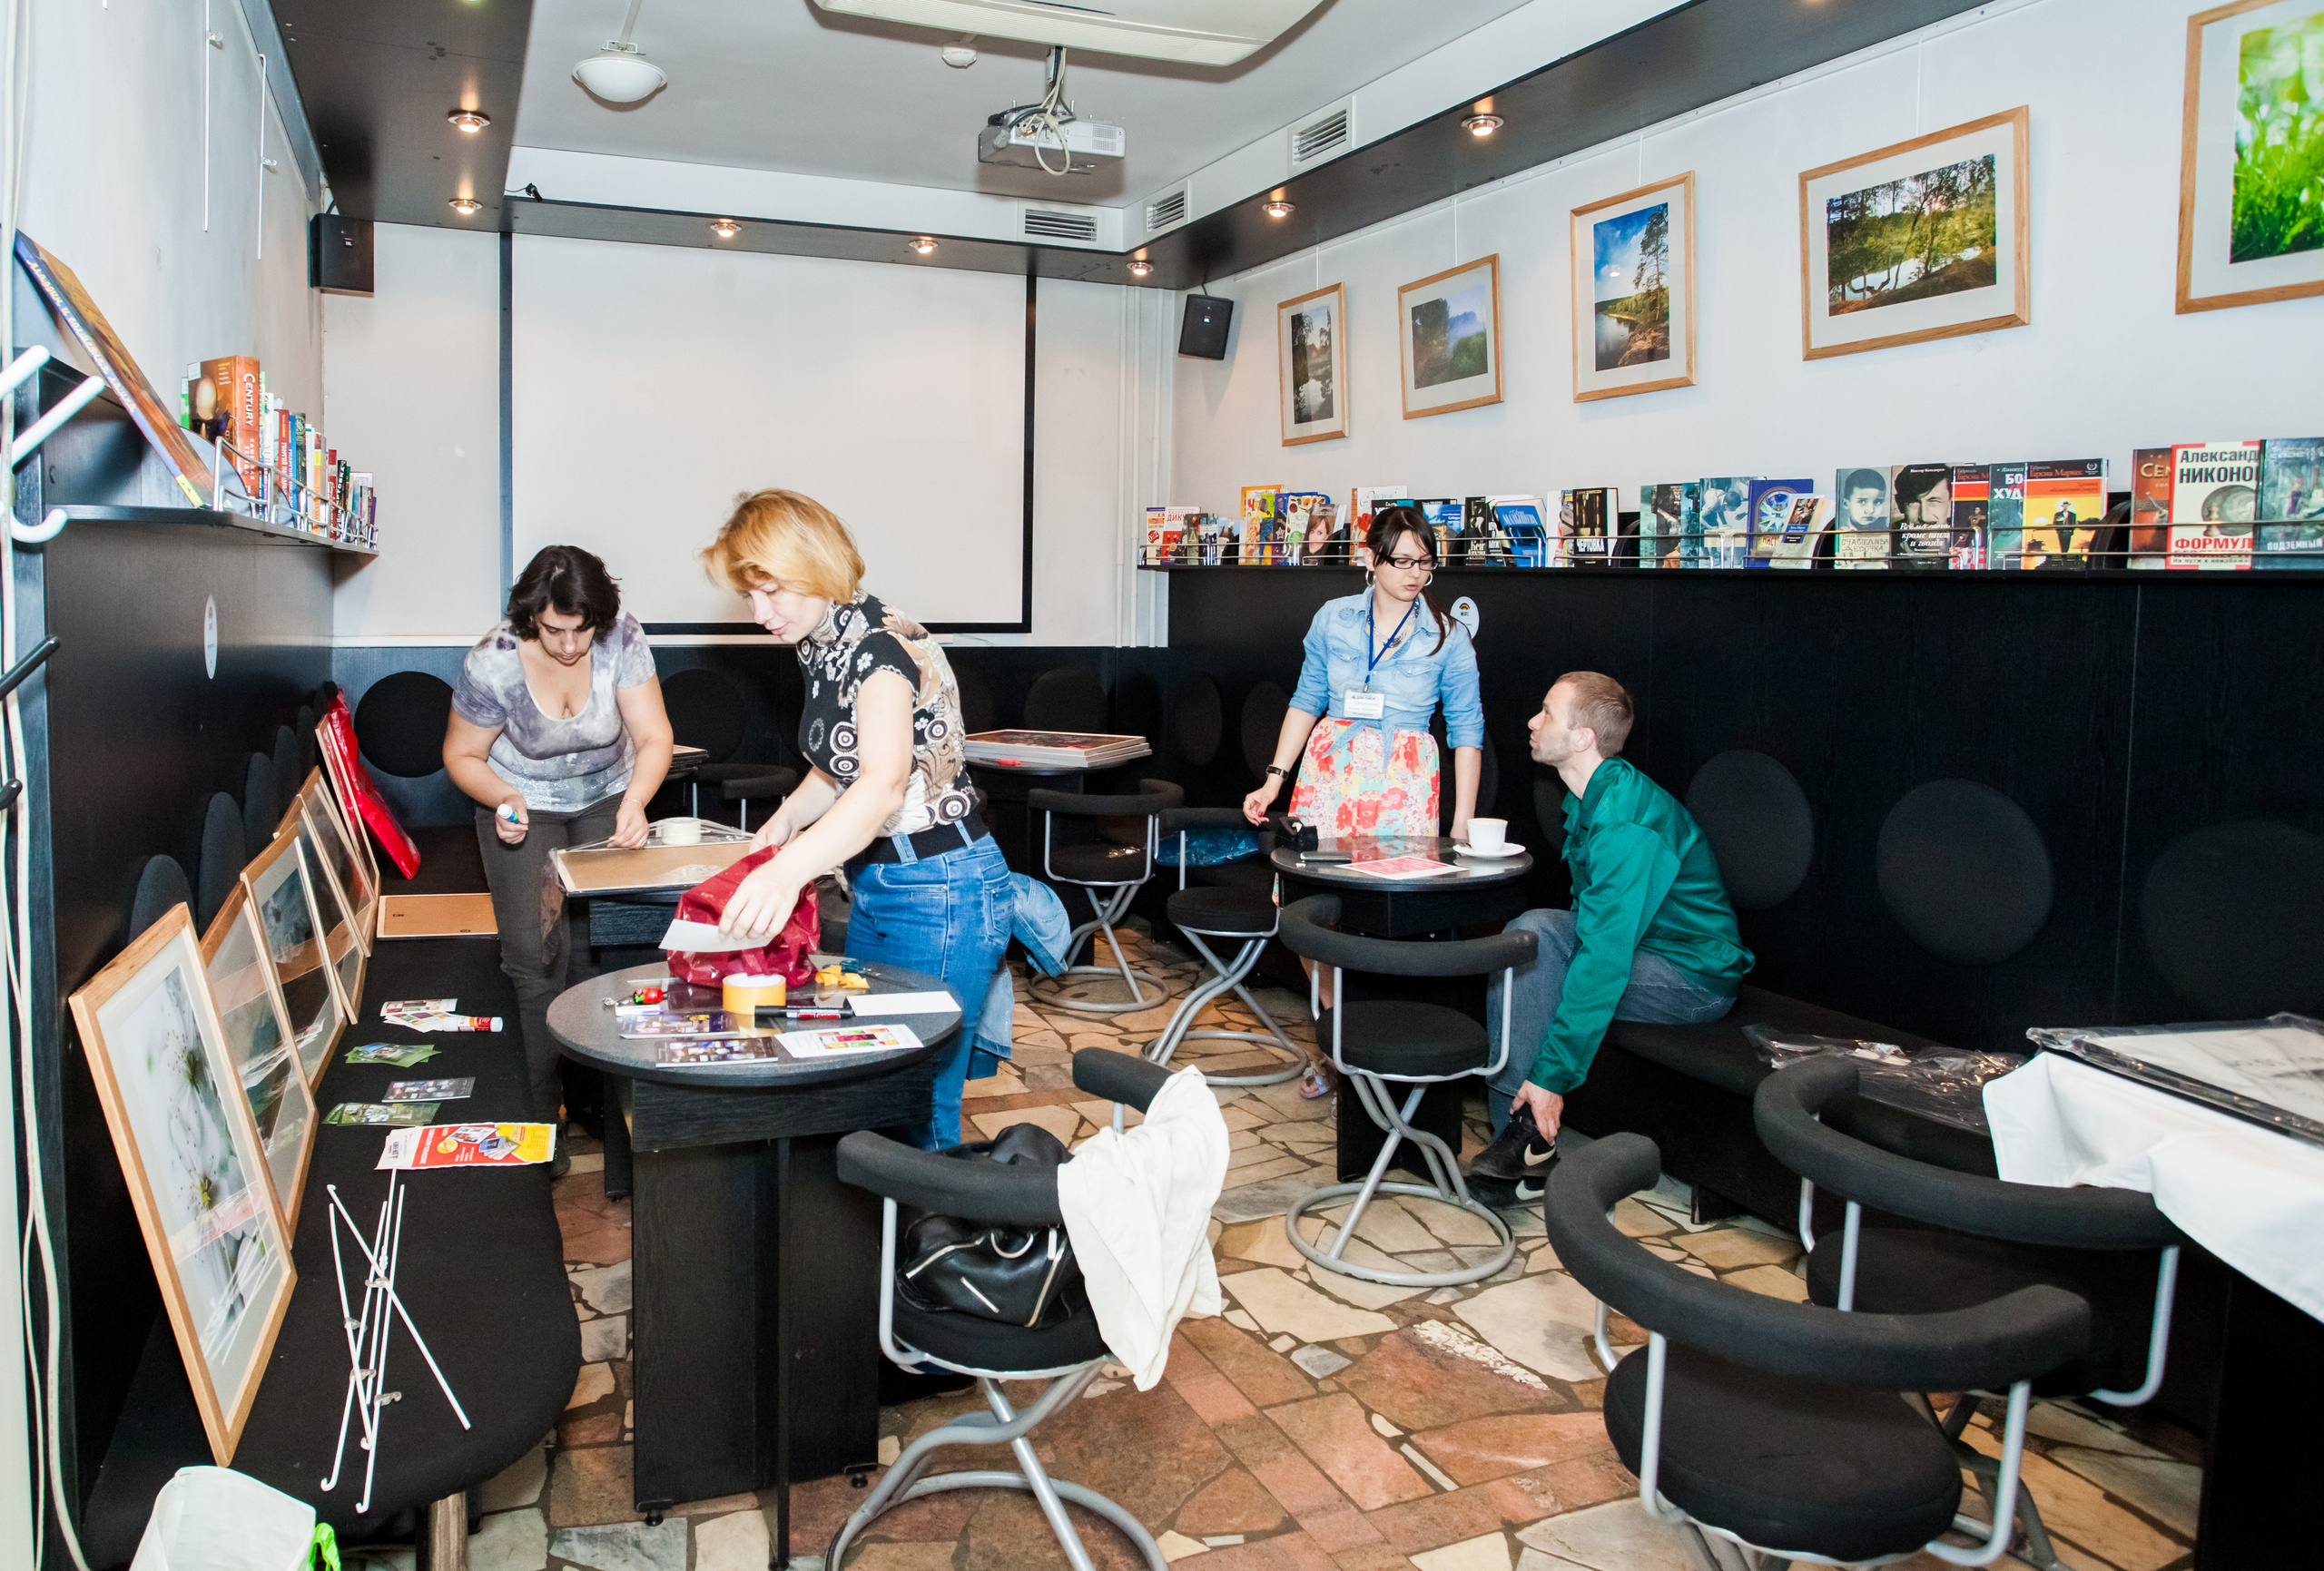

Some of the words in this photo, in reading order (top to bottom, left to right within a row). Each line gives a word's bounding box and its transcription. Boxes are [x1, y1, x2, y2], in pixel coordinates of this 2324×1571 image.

[243, 373, 256, 427] CENTURY
[2179, 466, 2259, 484] НИКОНО
[2267, 538, 2323, 551] ПОДЗЕМНЫЙ
